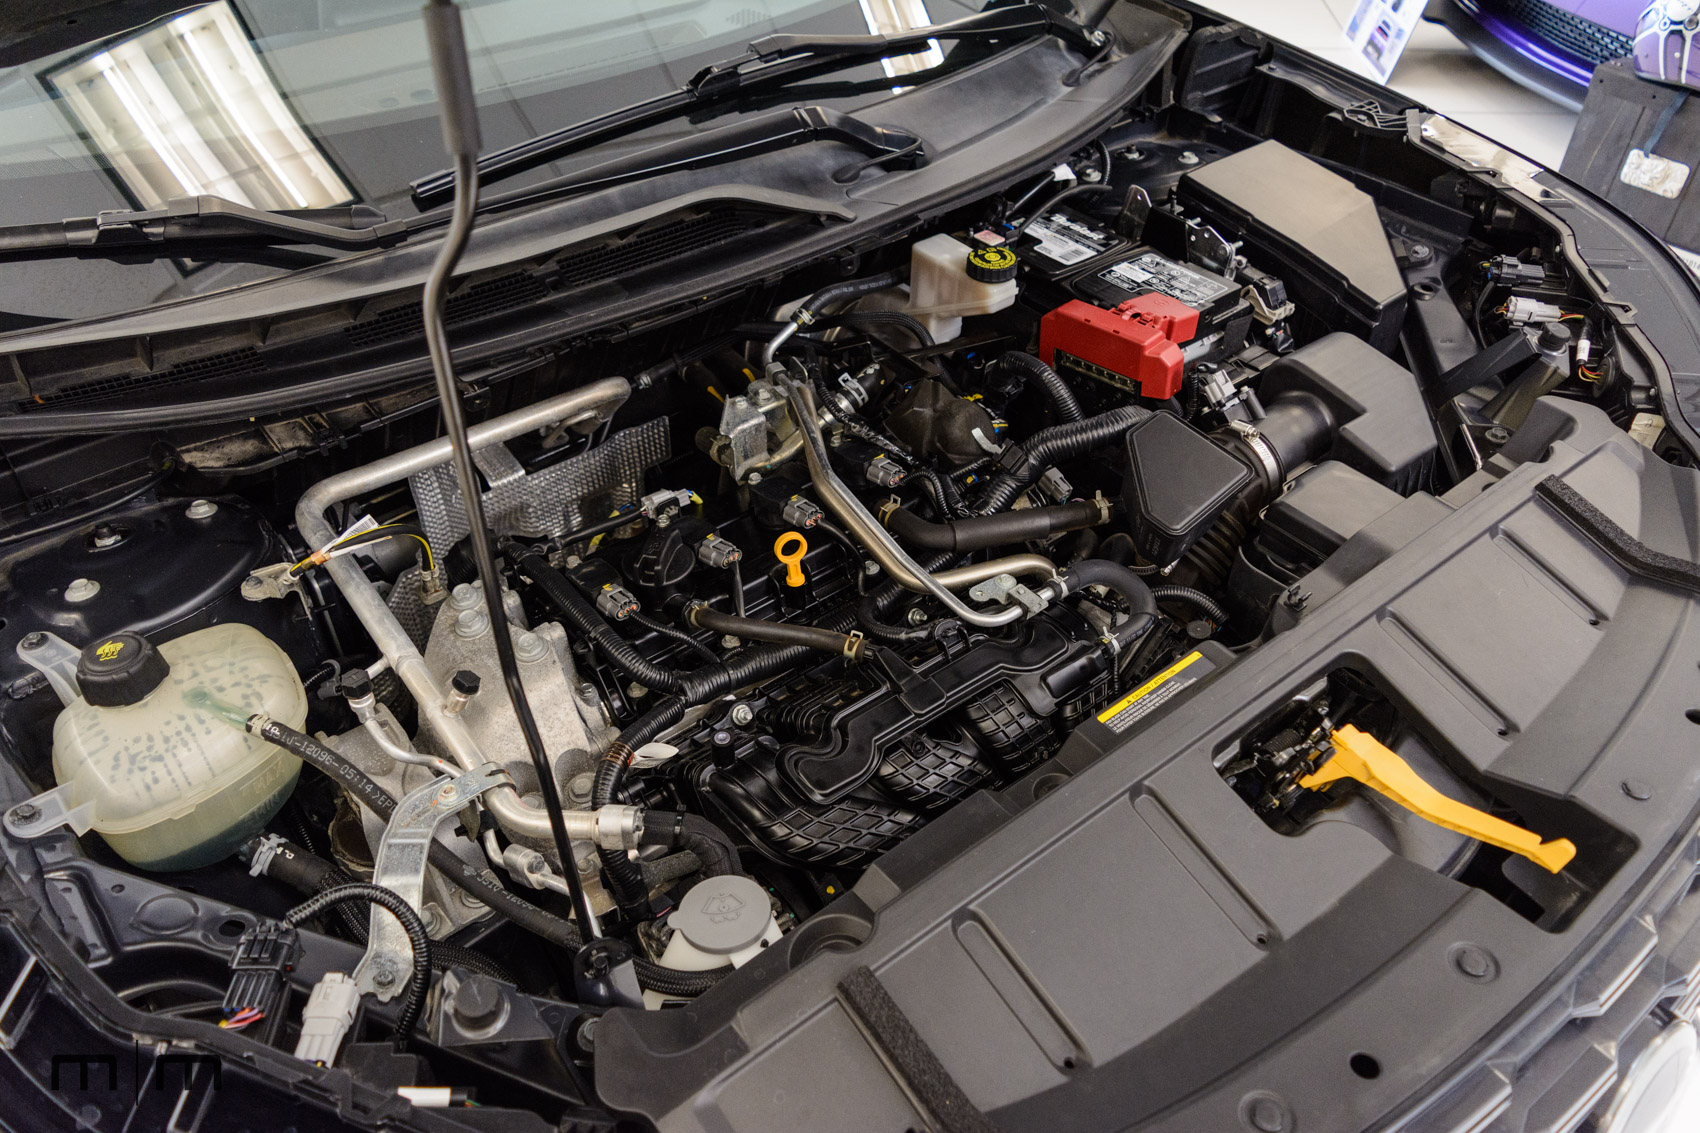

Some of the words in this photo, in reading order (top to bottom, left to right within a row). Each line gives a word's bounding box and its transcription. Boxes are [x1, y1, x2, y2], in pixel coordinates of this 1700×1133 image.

[1050, 213, 1107, 241] Duralast
[1131, 685, 1151, 699] CAUTION
[1153, 669, 1175, 685] ATTENTION
